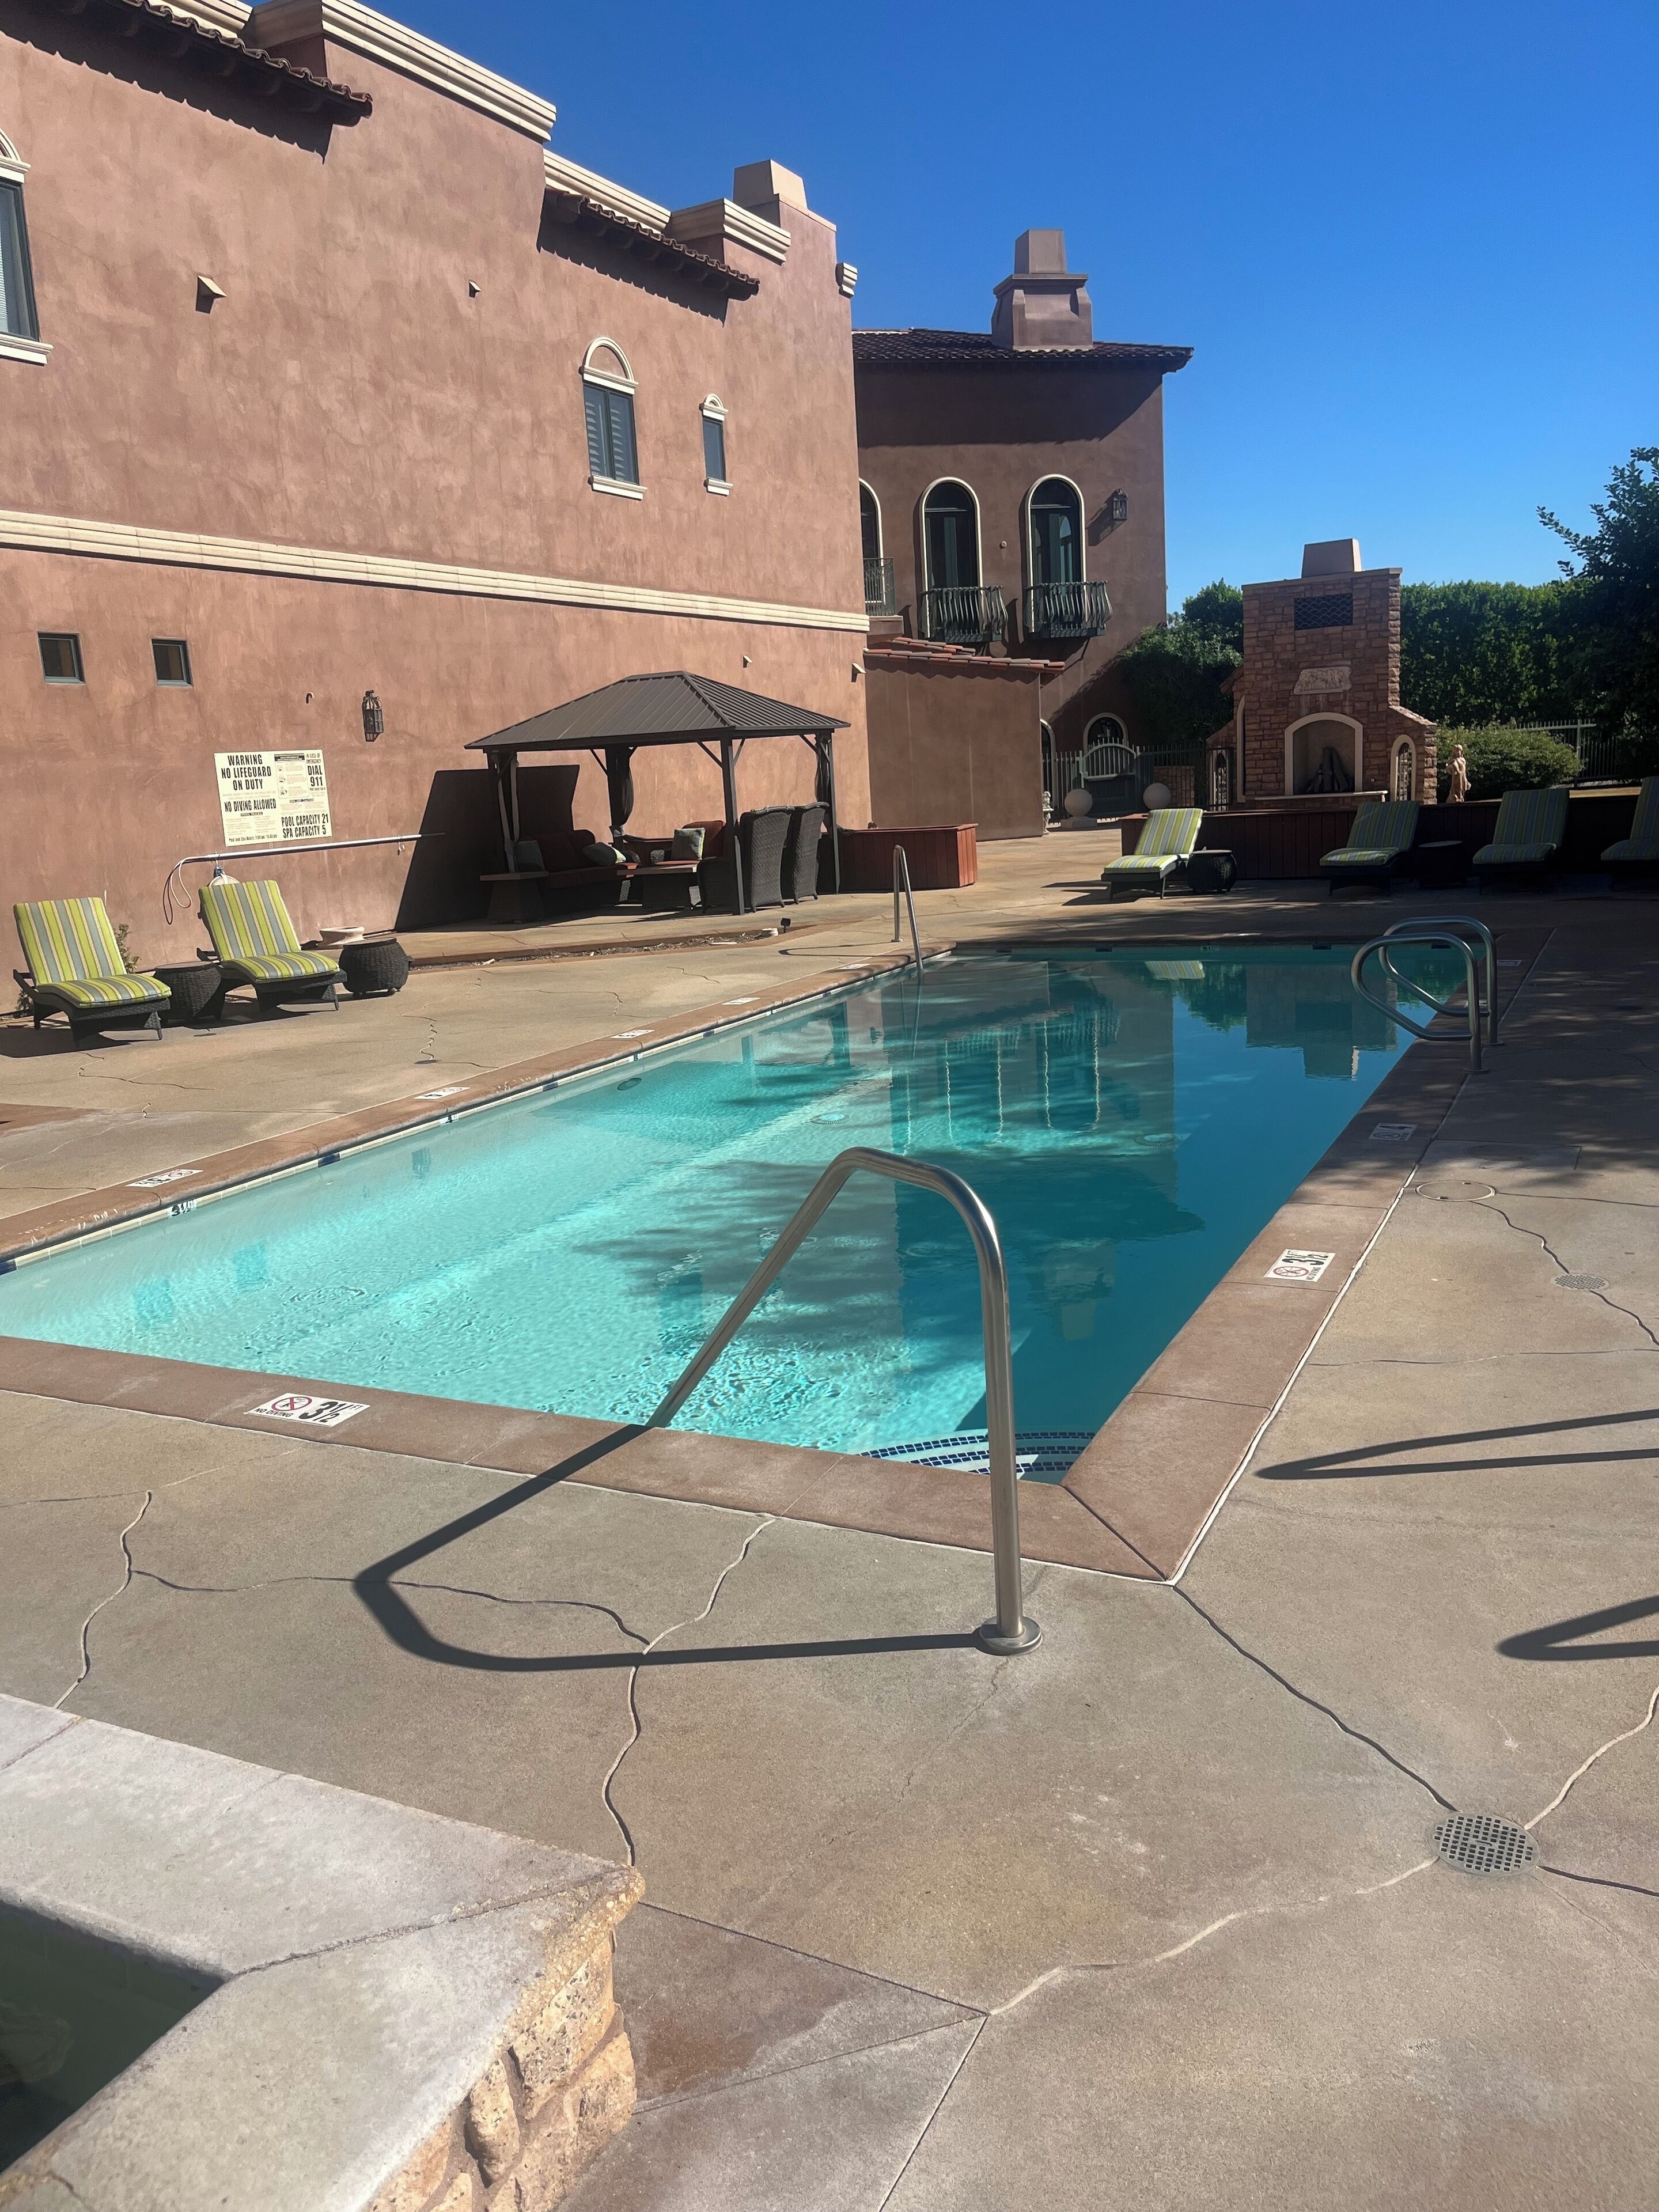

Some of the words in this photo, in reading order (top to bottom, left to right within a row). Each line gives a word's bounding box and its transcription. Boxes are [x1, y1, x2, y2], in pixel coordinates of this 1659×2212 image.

[228, 754, 263, 766] WARNING
[221, 768, 231, 779] NO
[233, 766, 271, 778] LIFEGUARD
[308, 765, 323, 776] DIAL
[233, 779, 243, 790] ON
[245, 779, 263, 790] DUTY
[310, 776, 323, 786] 911
[224, 801, 232, 812] NO
[233, 800, 252, 812] DIVING
[253, 798, 276, 810] ALLOWED
[281, 816, 295, 827] POOL
[296, 814, 320, 826] CAPACITY
[321, 813, 329, 824] 21
[282, 827, 293, 839] SPA
[294, 825, 320, 838] CAPACITY
[322, 825, 327, 835] 5
[265, 1410, 294, 1418] DIVING
